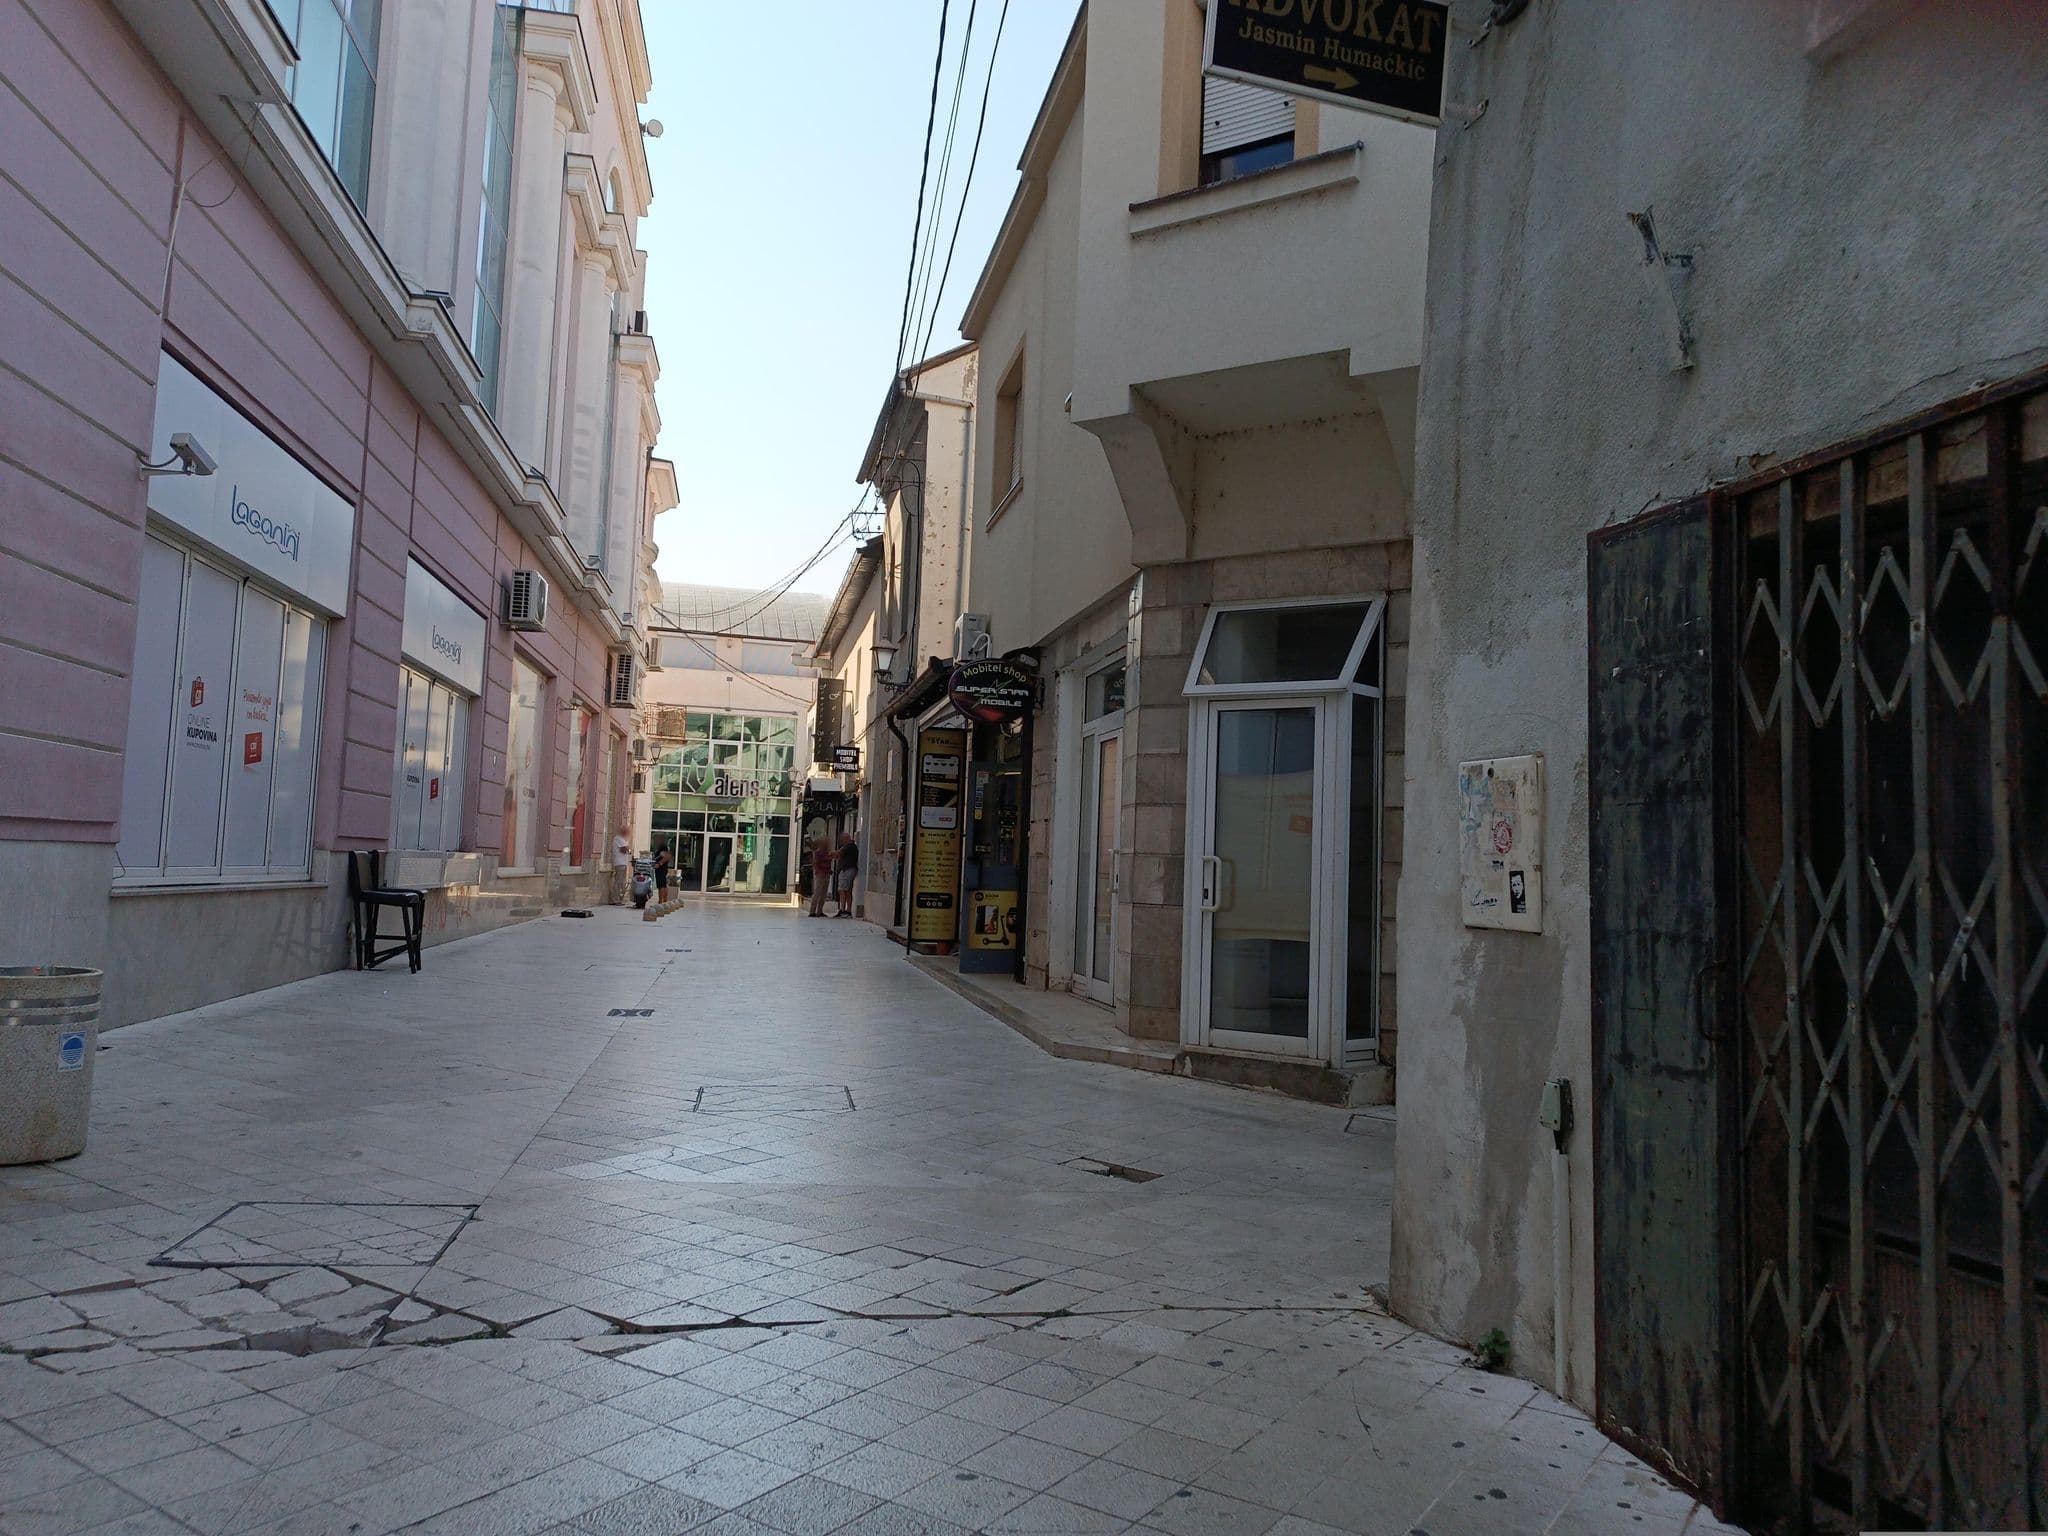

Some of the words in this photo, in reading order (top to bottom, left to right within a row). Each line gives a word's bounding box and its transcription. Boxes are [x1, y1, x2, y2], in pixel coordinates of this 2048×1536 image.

[1228, 0, 1440, 53] VOKAT
[1239, 16, 1315, 55] Jasmin
[963, 664, 1002, 679] Mobitel
[1004, 666, 1027, 682] shop
[981, 699, 1022, 707] MOBILE
[187, 727, 217, 743] KUPOVINA
